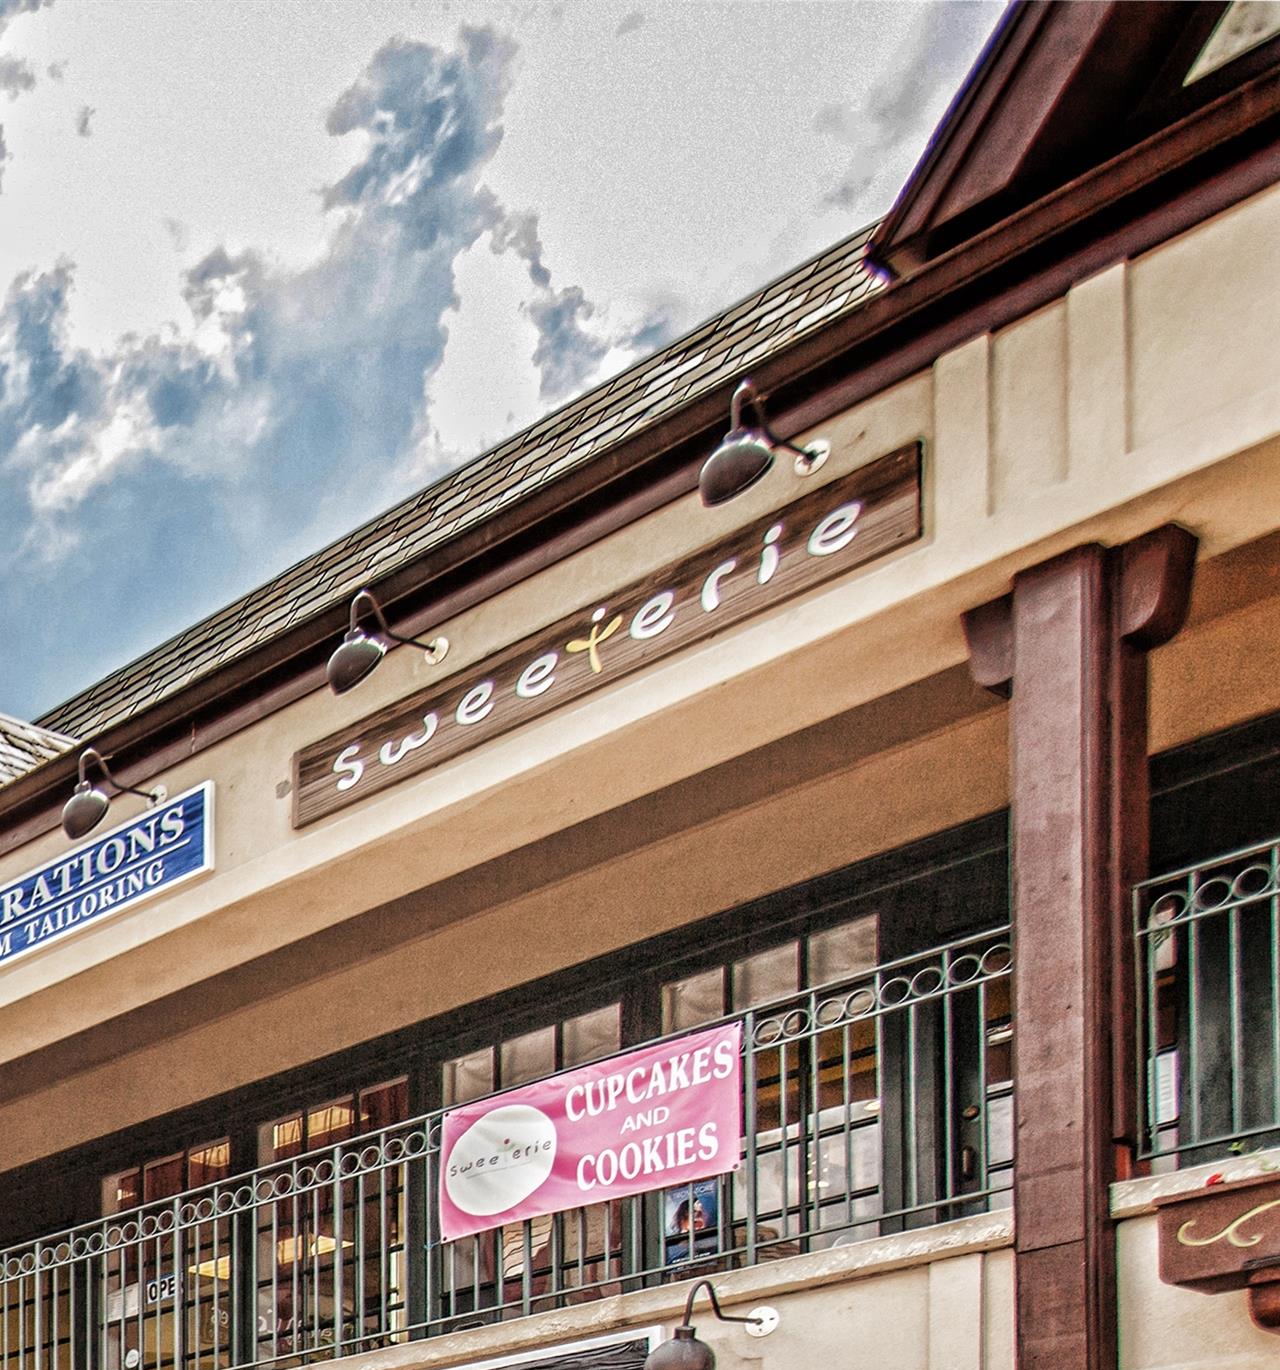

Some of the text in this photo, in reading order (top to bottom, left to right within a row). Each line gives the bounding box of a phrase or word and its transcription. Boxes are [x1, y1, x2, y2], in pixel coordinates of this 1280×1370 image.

[24, 861, 166, 946] TAILORING
[565, 1040, 734, 1122] CUPCAKES
[620, 1105, 670, 1135] AND
[450, 1139, 552, 1178] sweeerie
[577, 1122, 719, 1192] COOKIES
[149, 1277, 176, 1301] OPE
